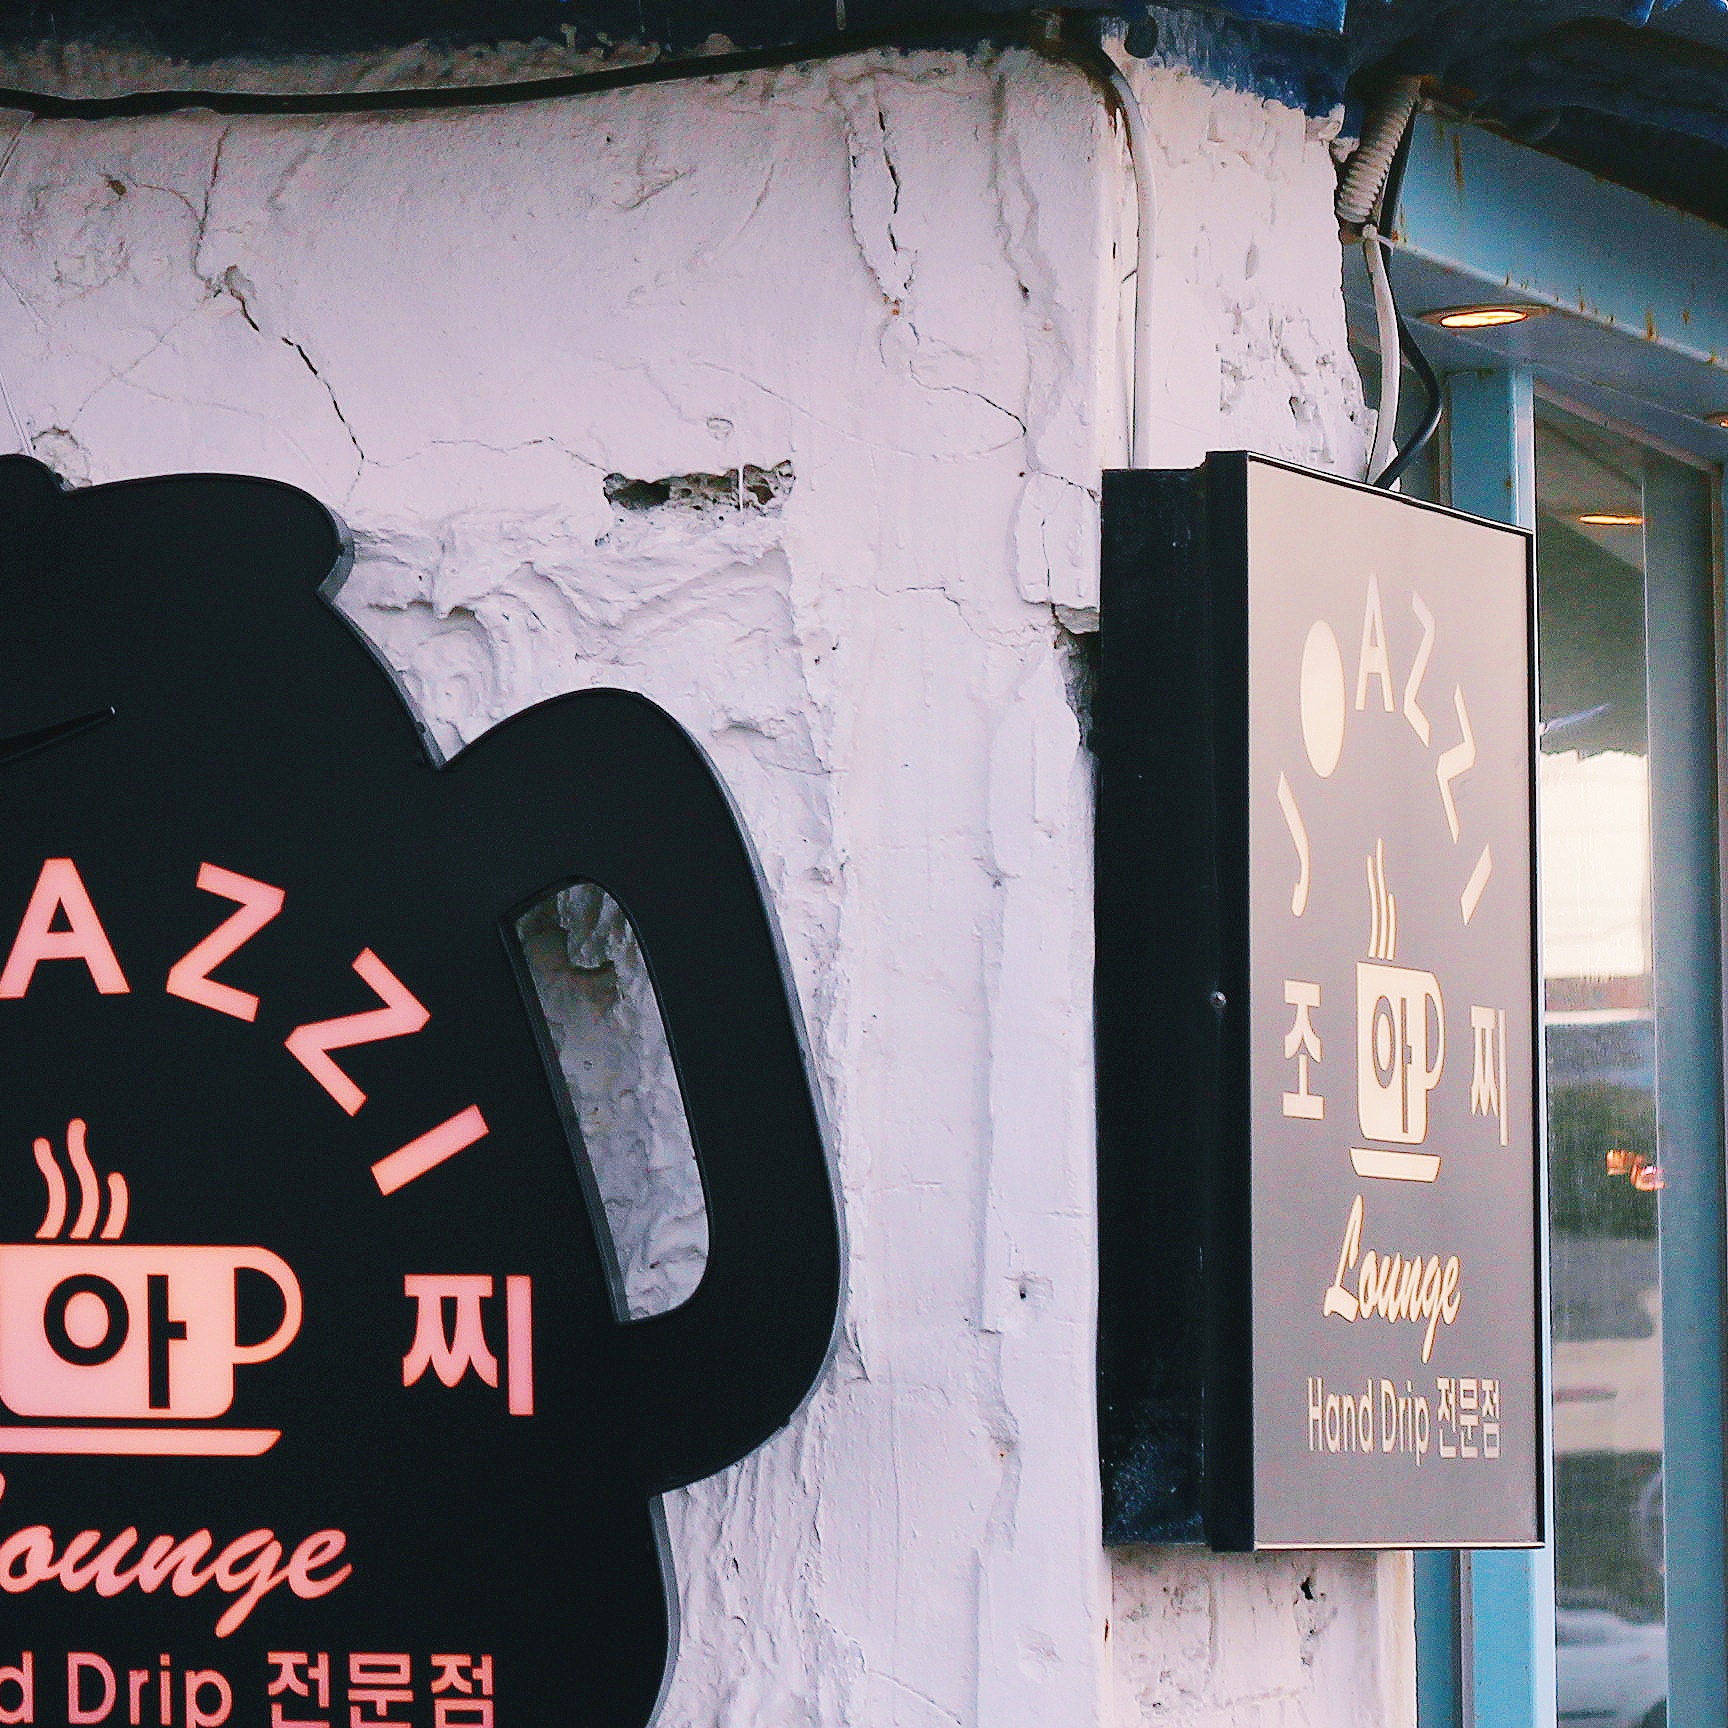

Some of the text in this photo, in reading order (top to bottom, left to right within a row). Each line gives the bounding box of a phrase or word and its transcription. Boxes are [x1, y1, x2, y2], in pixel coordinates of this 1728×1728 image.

[1323, 1194, 1461, 1364] Lounge
[1307, 1376, 1501, 1468] Hand Drip 전문점
[67, 1651, 234, 1728] Drip
[267, 1651, 494, 1728] 전문점
